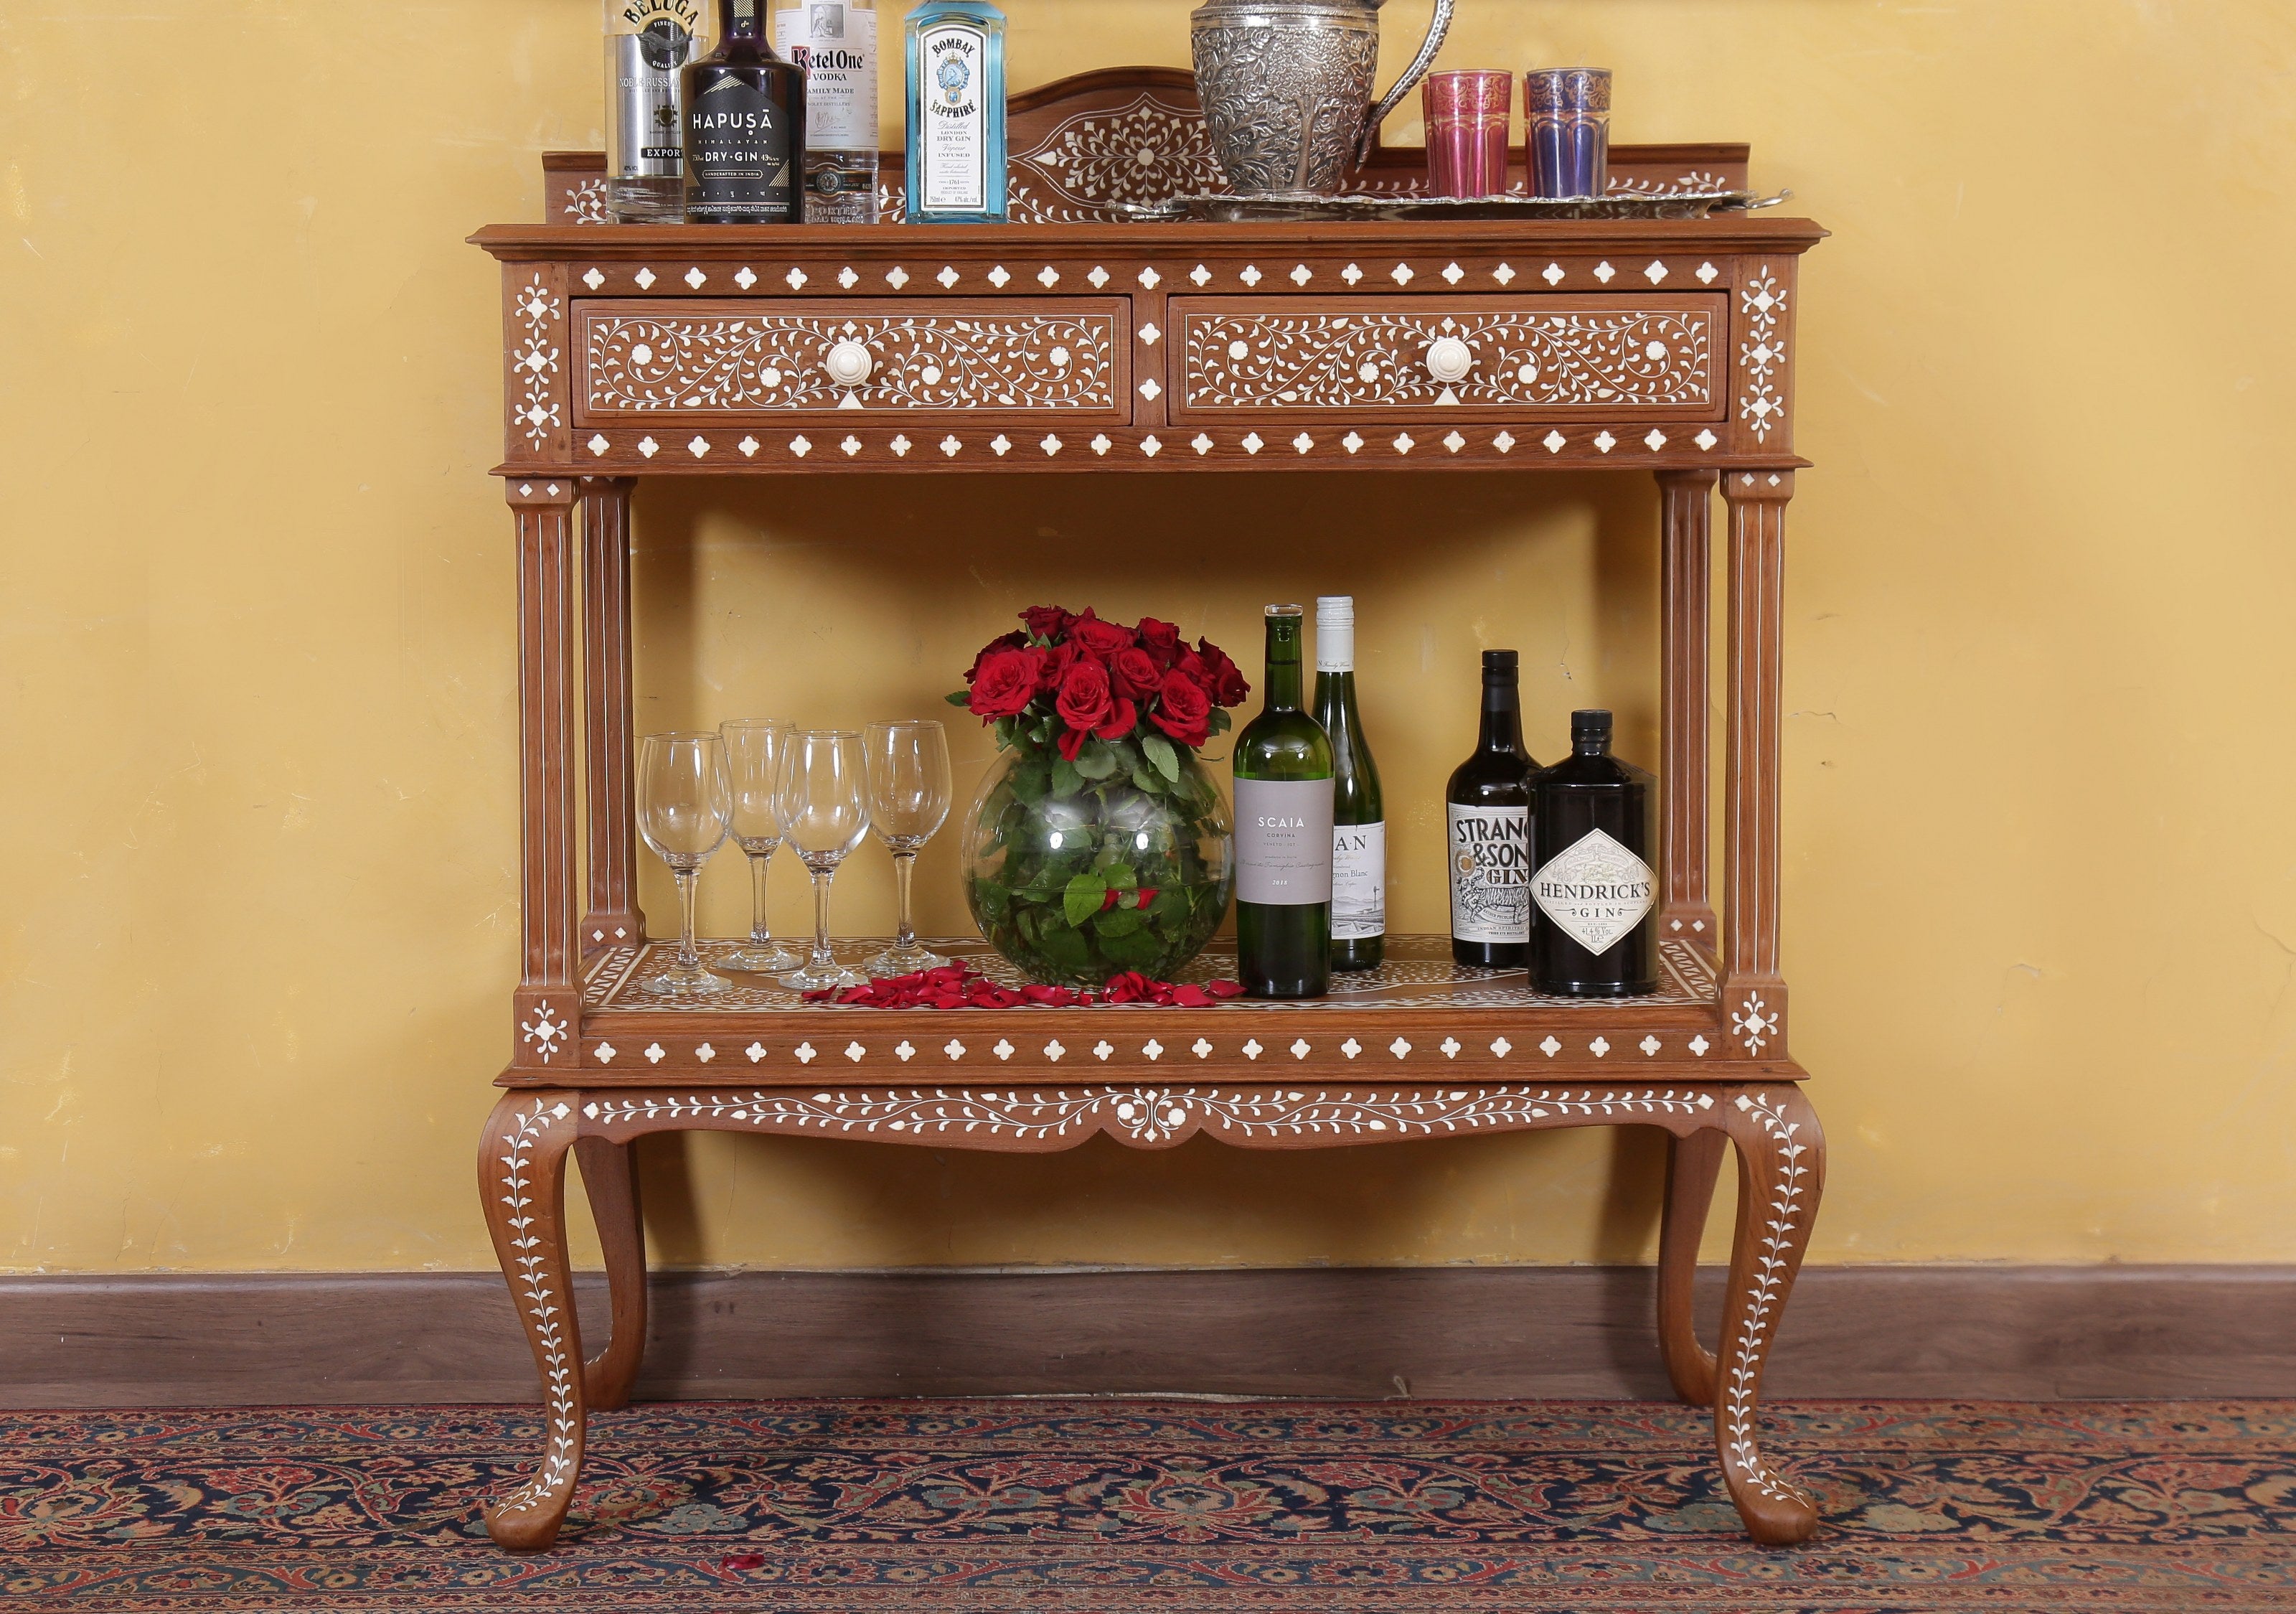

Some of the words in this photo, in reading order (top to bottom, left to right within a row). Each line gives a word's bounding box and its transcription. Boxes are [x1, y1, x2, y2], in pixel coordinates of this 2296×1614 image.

[623, 0, 699, 26] BELUGA
[932, 38, 975, 57] BOMBAY
[792, 49, 834, 72] Ketel
[836, 50, 863, 70] One
[930, 99, 976, 118] SAPPHIRE
[647, 149, 682, 157] EXPOR
[705, 151, 728, 161] DRY
[734, 151, 758, 161] GIN
[1258, 817, 1304, 828] SCAIA
[1487, 869, 1529, 885] GIN
[1540, 882, 1650, 899] HENDRICK'S
[1580, 908, 1615, 918] GIN
